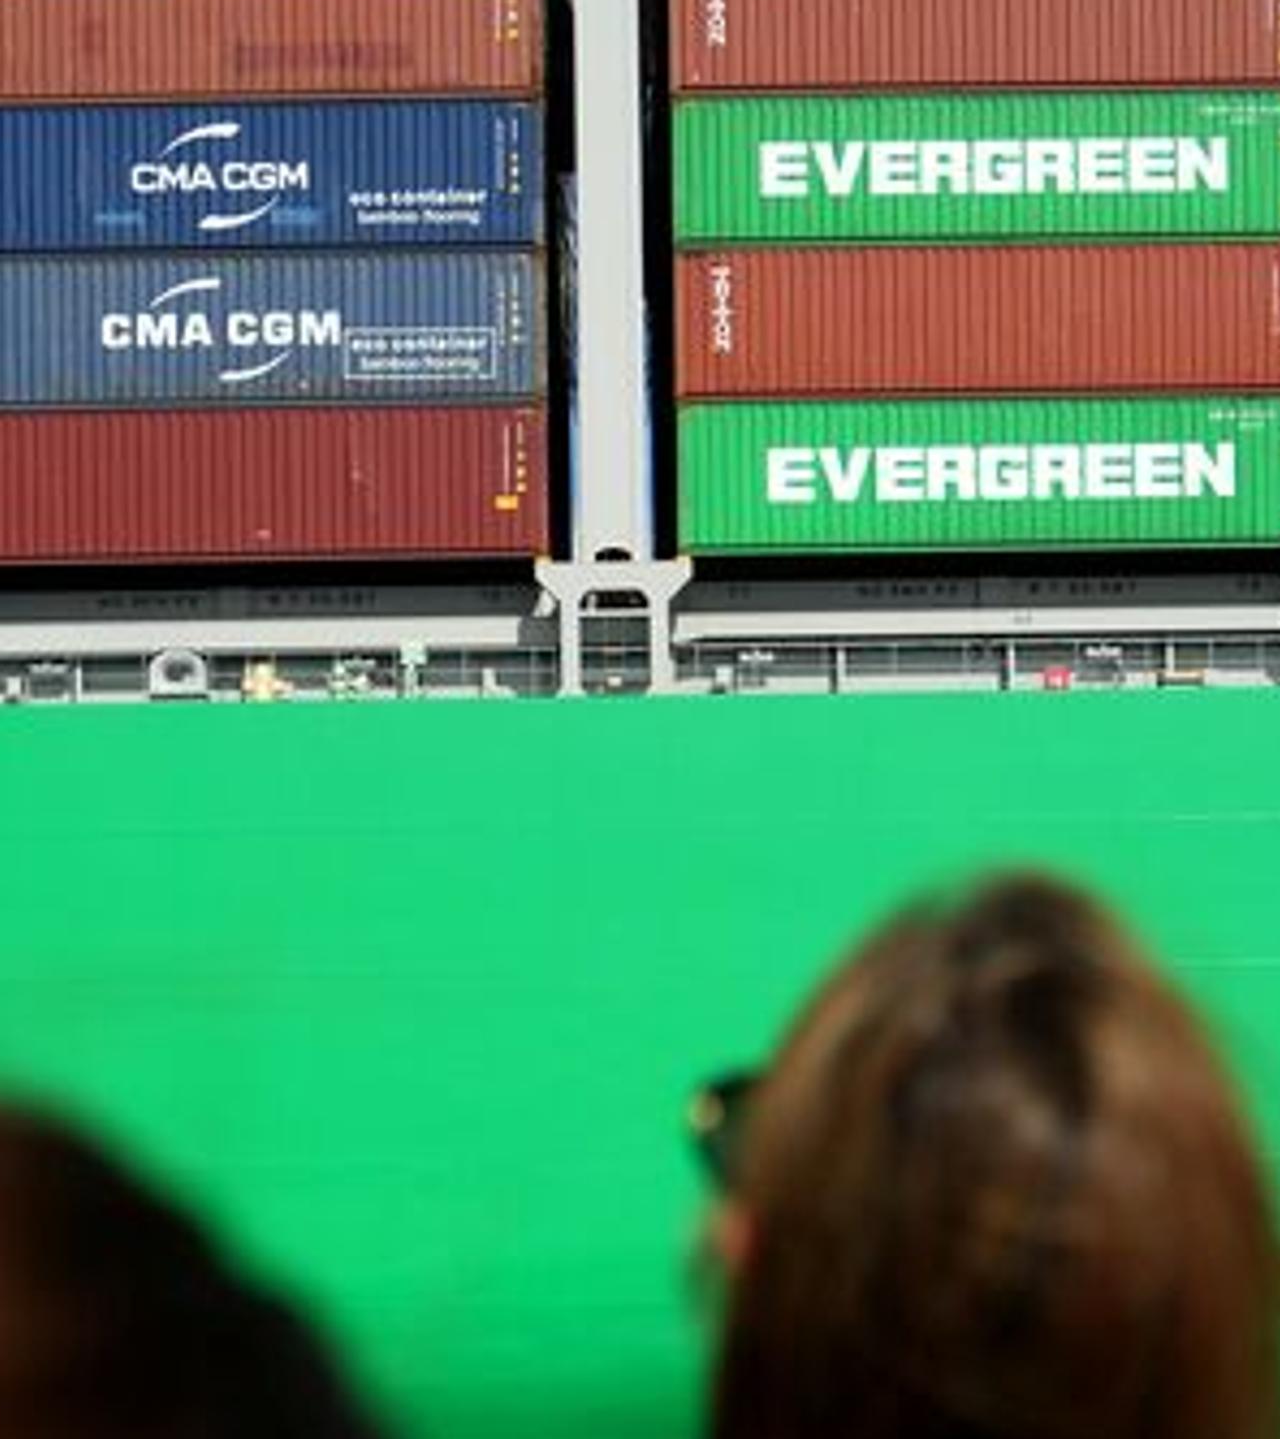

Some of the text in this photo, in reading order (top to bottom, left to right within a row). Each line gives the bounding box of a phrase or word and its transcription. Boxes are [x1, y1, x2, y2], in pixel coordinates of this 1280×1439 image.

[132, 162, 308, 191] CMA CGM
[760, 137, 1227, 196] EVERGREEN
[101, 311, 341, 348] CMA CGM
[767, 443, 1235, 502] EVERGREEN
